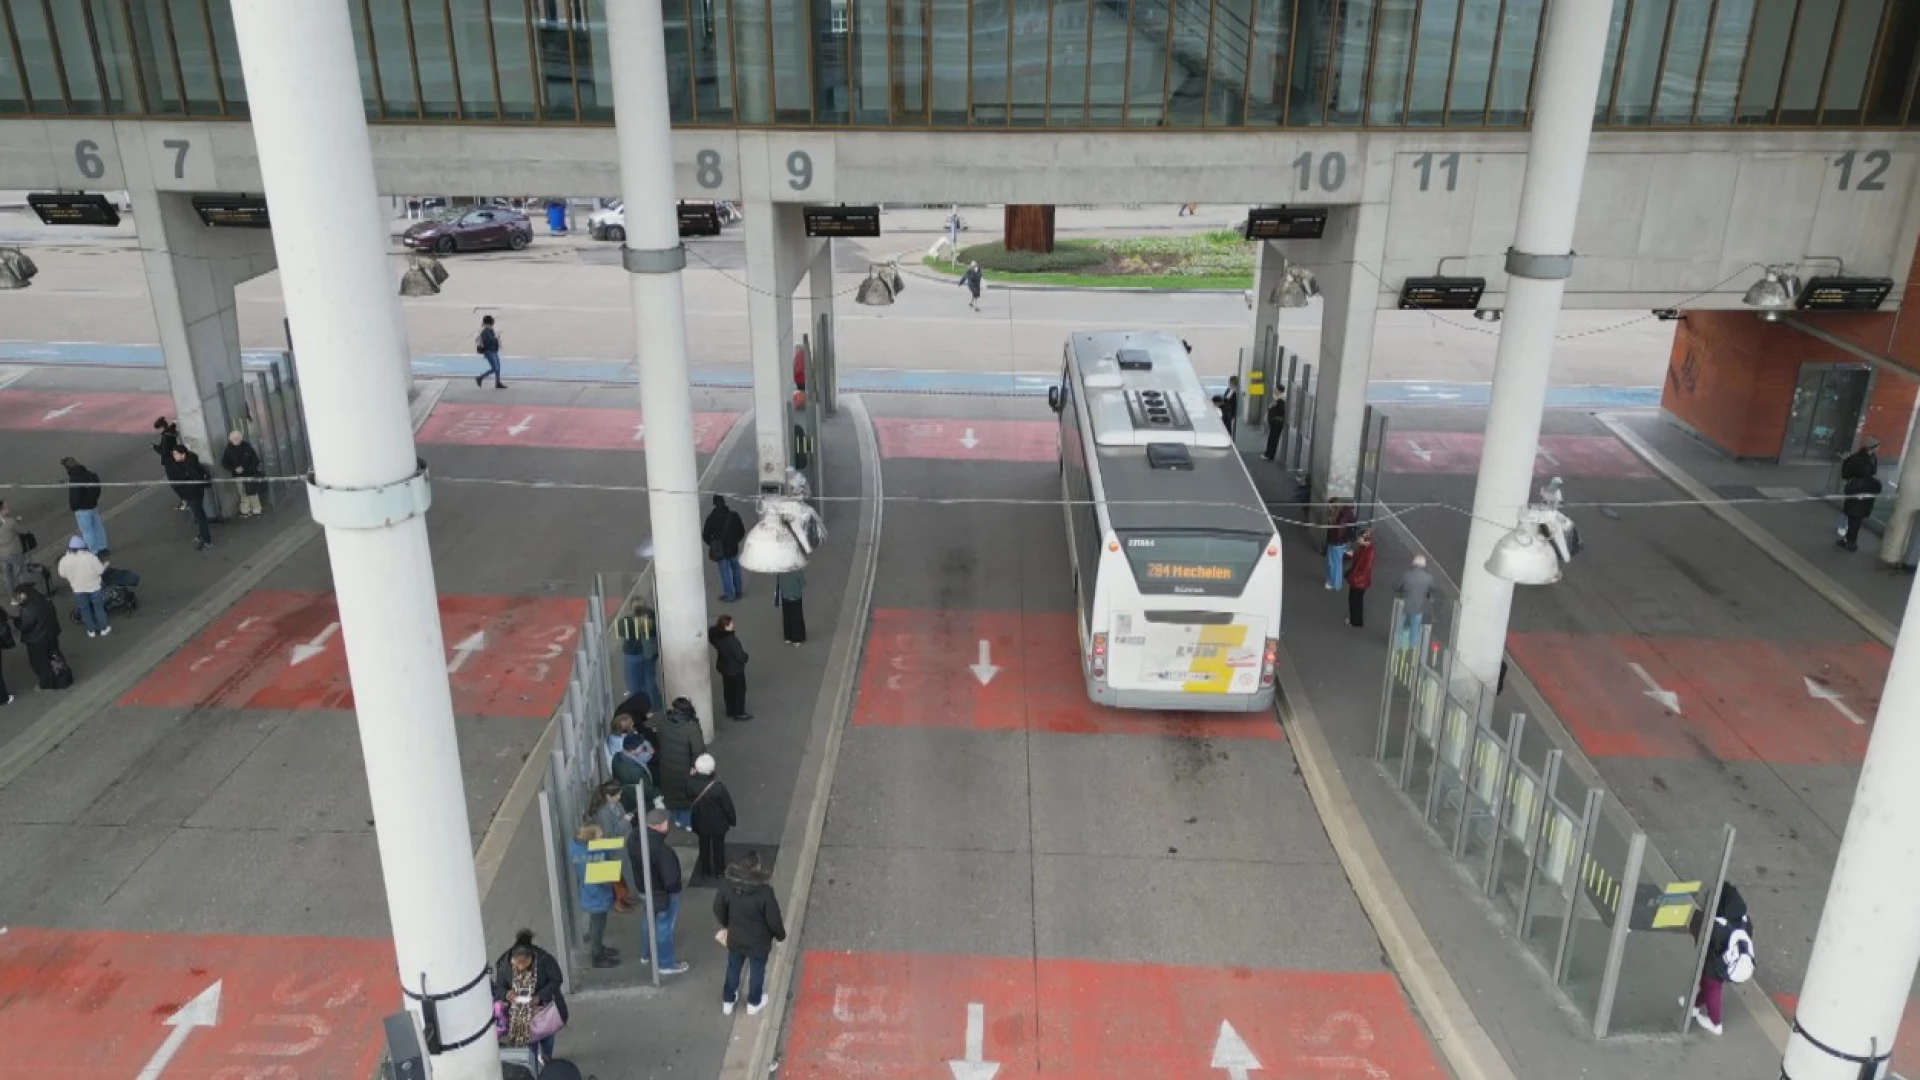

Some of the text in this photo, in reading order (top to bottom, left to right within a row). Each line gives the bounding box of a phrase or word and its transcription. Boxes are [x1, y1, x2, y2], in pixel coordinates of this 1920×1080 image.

[75, 139, 105, 179] 6
[163, 139, 190, 179] 7
[696, 149, 723, 189] 8
[786, 150, 813, 190] 9
[1292, 151, 1346, 192] 10
[1413, 152, 1460, 191] 11
[1833, 149, 1892, 191] 12
[1173, 564, 1232, 580] Mechelen
